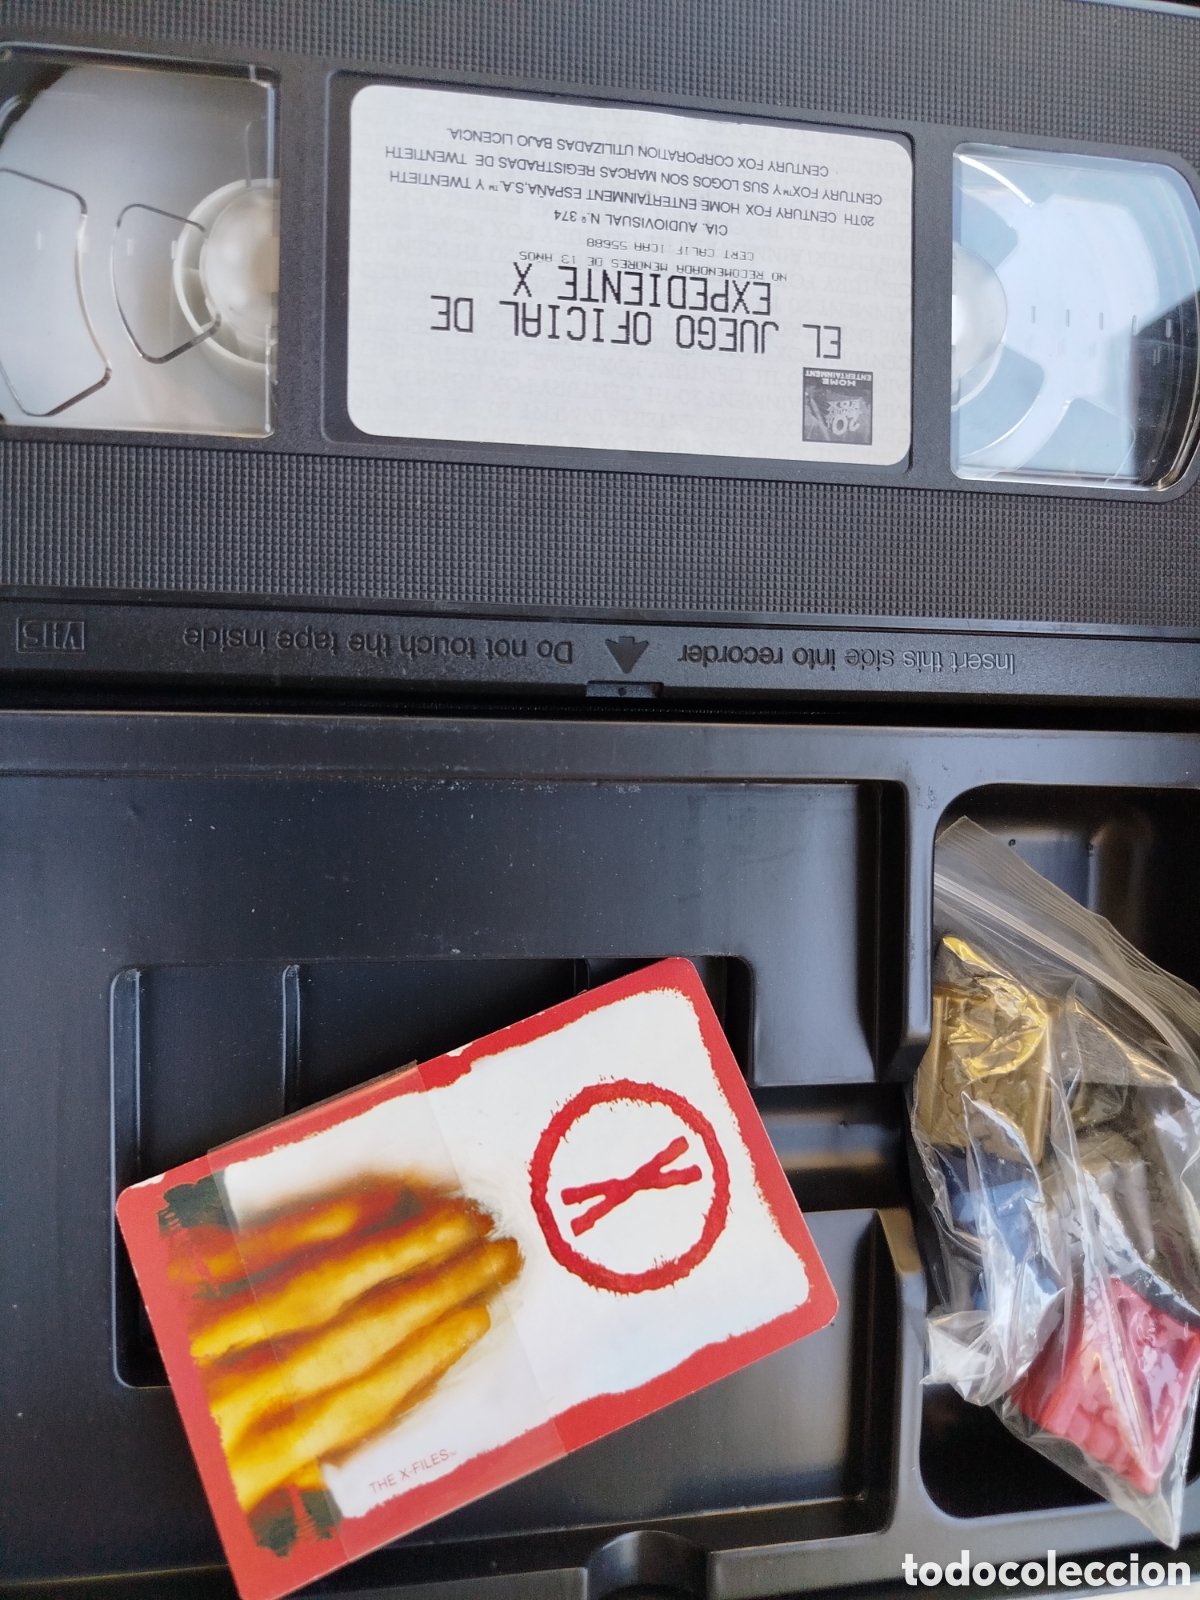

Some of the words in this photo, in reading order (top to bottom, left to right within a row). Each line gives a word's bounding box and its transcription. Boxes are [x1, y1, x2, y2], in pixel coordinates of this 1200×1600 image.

[446, 127, 514, 146] LICENCIA.
[516, 134, 553, 150] BAJO
[385, 145, 468, 166] TWENTIETH
[556, 138, 634, 157] UTILIZADAS
[637, 145, 735, 168] CORPORATION
[474, 154, 495, 168] DE
[497, 156, 596, 178] REGISTRADAS
[737, 156, 764, 171] FOX
[767, 160, 830, 178] CENTURY
[389, 170, 472, 190] TWENTIETH
[599, 165, 657, 183] MARCAS
[660, 172, 690, 187] SON
[692, 175, 740, 192] LOGOS
[742, 180, 770, 195] SUS
[821, 188, 883, 206] CENTURY
[585, 188, 698, 211] ENTERTAINMENT
[700, 199, 740, 215] HOME
[553, 209, 578, 223] 374
[745, 203, 772, 218] FOX
[775, 206, 837, 224] CENTURY
[604, 213, 699, 234] AUDIOVISUAL
[702, 222, 729, 237] CIA.
[844, 213, 875, 228] 20TH
[586, 237, 628, 251] 55688
[633, 241, 665, 254] ICAA
[675, 245, 715, 258] CALIF
[560, 254, 577, 267] 13
[587, 256, 605, 269] DE
[723, 249, 755, 262] CERT
[610, 258, 670, 273] MENORES
[675, 264, 765, 281] RECOMENDADA
[512, 261, 534, 298] X
[771, 271, 788, 283] NO
[556, 265, 772, 316] EXPEDIENTE
[429, 294, 475, 334] DE
[498, 299, 653, 347] OFICIAL
[675, 314, 780, 355] JUEGO
[801, 323, 842, 360] EL
[804, 370, 872, 381] ENTERTAINMENT
[822, 378, 856, 386] HOME
[20, 619, 83, 651] VHS
[181, 627, 266, 654] inside
[275, 625, 338, 656] tape
[346, 631, 390, 658] the
[399, 634, 477, 661] touch
[486, 637, 528, 661] not
[536, 639, 574, 665] Do
[677, 644, 784, 668] recorder
[791, 646, 836, 671] into
[844, 648, 895, 672] side
[903, 650, 943, 673] this
[950, 651, 1015, 675] Insert
[368, 1473, 397, 1494] THE
